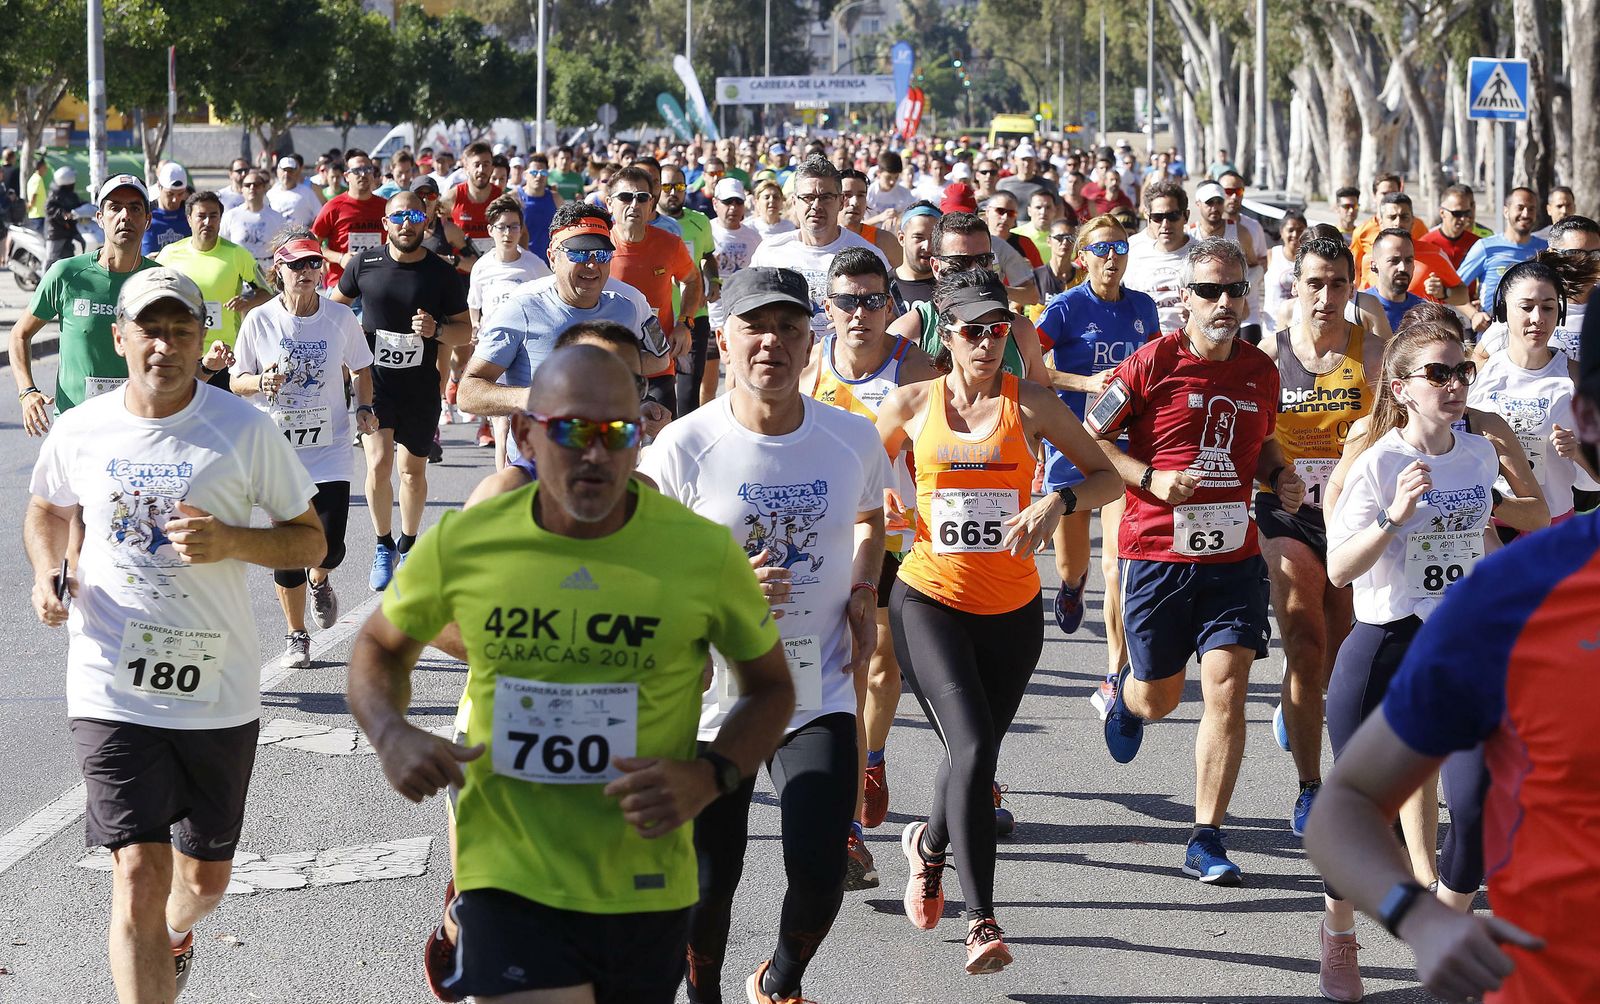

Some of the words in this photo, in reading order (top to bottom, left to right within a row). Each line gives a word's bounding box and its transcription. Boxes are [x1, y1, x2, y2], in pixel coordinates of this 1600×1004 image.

[750, 80, 796, 90] CARRERA
[798, 80, 810, 88] DE
[814, 80, 826, 88] LA
[829, 79, 866, 88] PRENSA
[380, 348, 416, 364] 297
[1282, 386, 1362, 404] bichos
[1282, 401, 1362, 413] runners
[938, 444, 1001, 462] MARTHA
[1196, 450, 1232, 462] MMCG
[117, 463, 178, 477] Carrera
[1188, 460, 1236, 471] 2019
[748, 485, 814, 500] Carrera
[1431, 490, 1476, 503] Carrera
[763, 494, 821, 508] Prensa
[940, 520, 1002, 546] 665
[1189, 530, 1225, 552] 63
[138, 623, 173, 636] CARRERA
[484, 607, 560, 640] 42K
[586, 613, 661, 647] CAF
[785, 638, 813, 647] PRENSA
[484, 642, 590, 664] CARACAS
[600, 649, 656, 670] 2016
[128, 657, 200, 693] 180
[514, 684, 558, 696] CARRERA
[560, 688, 573, 696] DE
[576, 688, 588, 696] LA
[590, 687, 628, 696] PRENSA
[508, 730, 610, 774] 760
